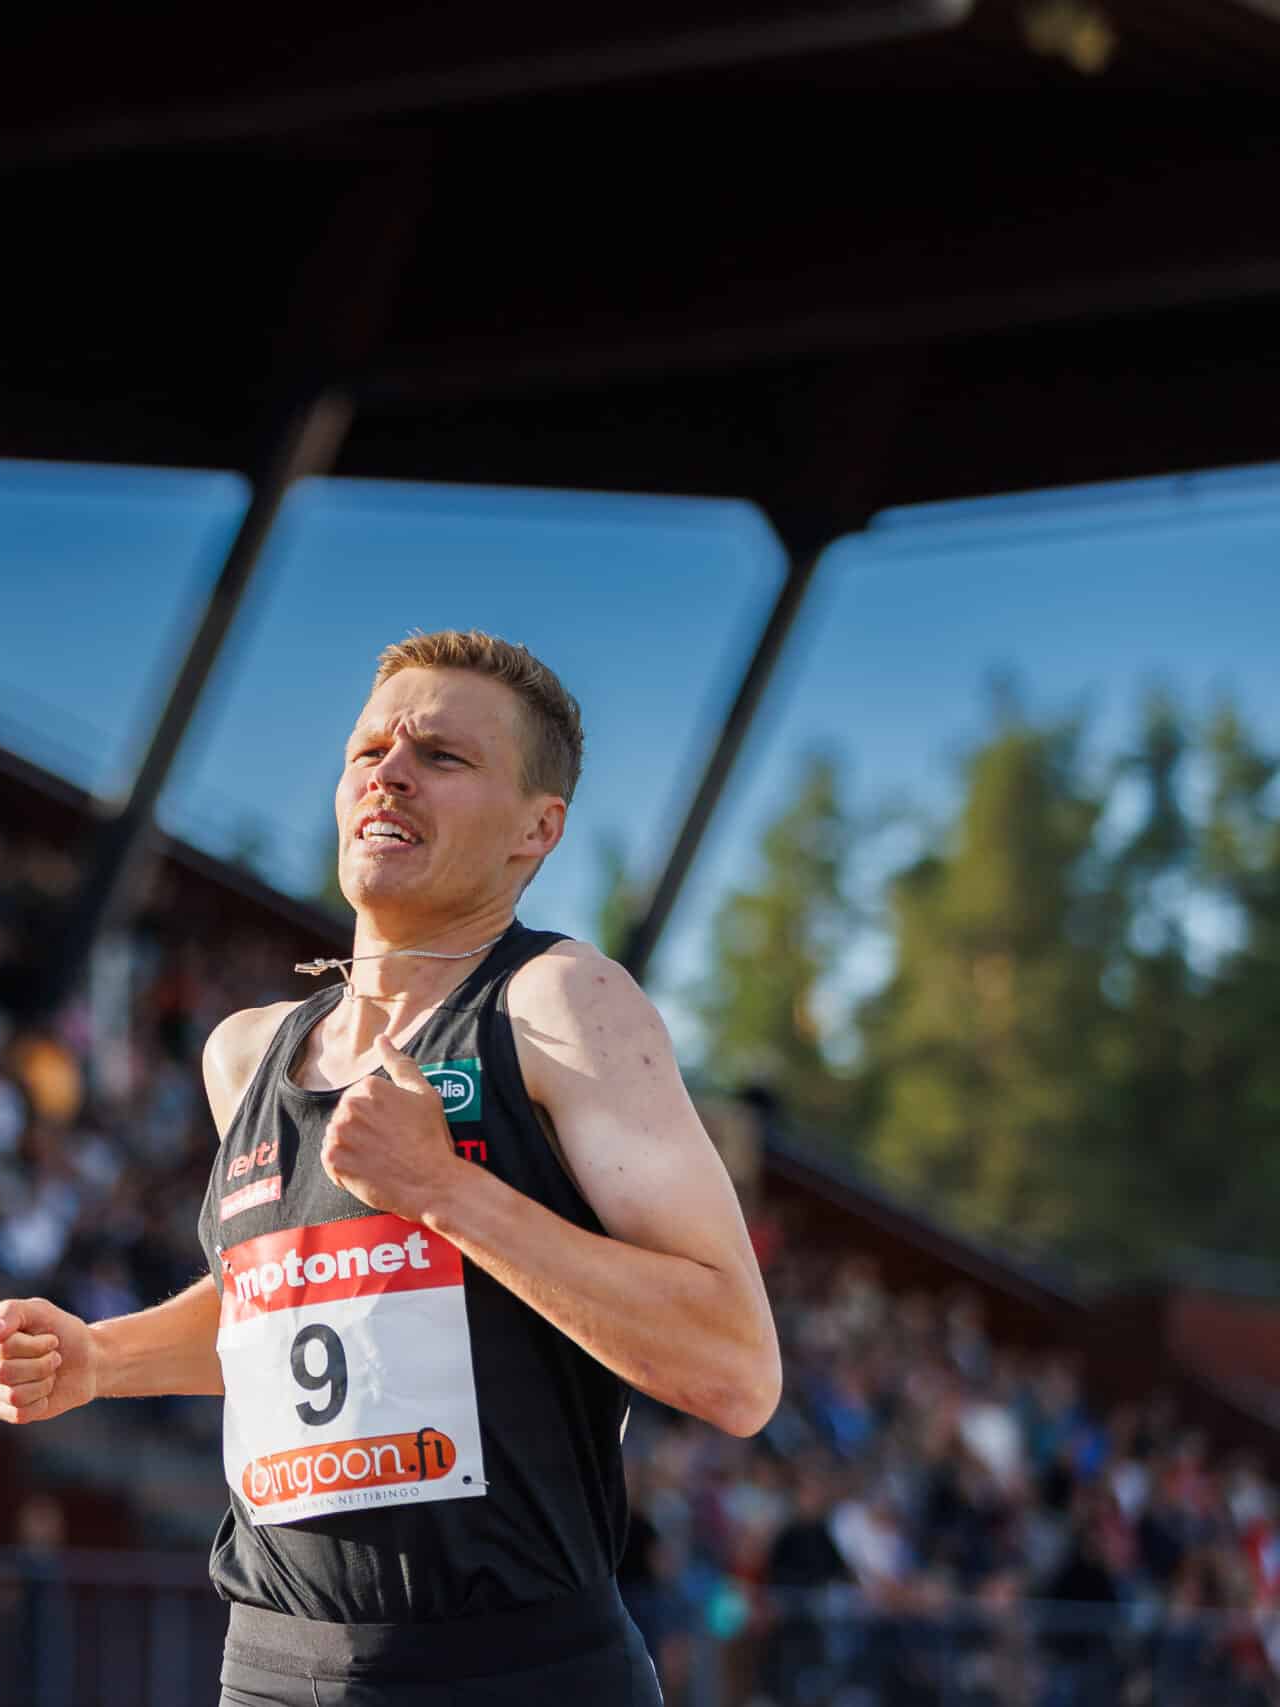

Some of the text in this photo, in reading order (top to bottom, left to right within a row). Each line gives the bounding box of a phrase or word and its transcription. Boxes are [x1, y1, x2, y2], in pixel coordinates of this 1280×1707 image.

[234, 1231, 431, 1302] motonet
[290, 1323, 348, 1426] 9
[250, 1426, 447, 1498] bingoon.fi
[337, 1487, 420, 1505] NETTIBINGO
